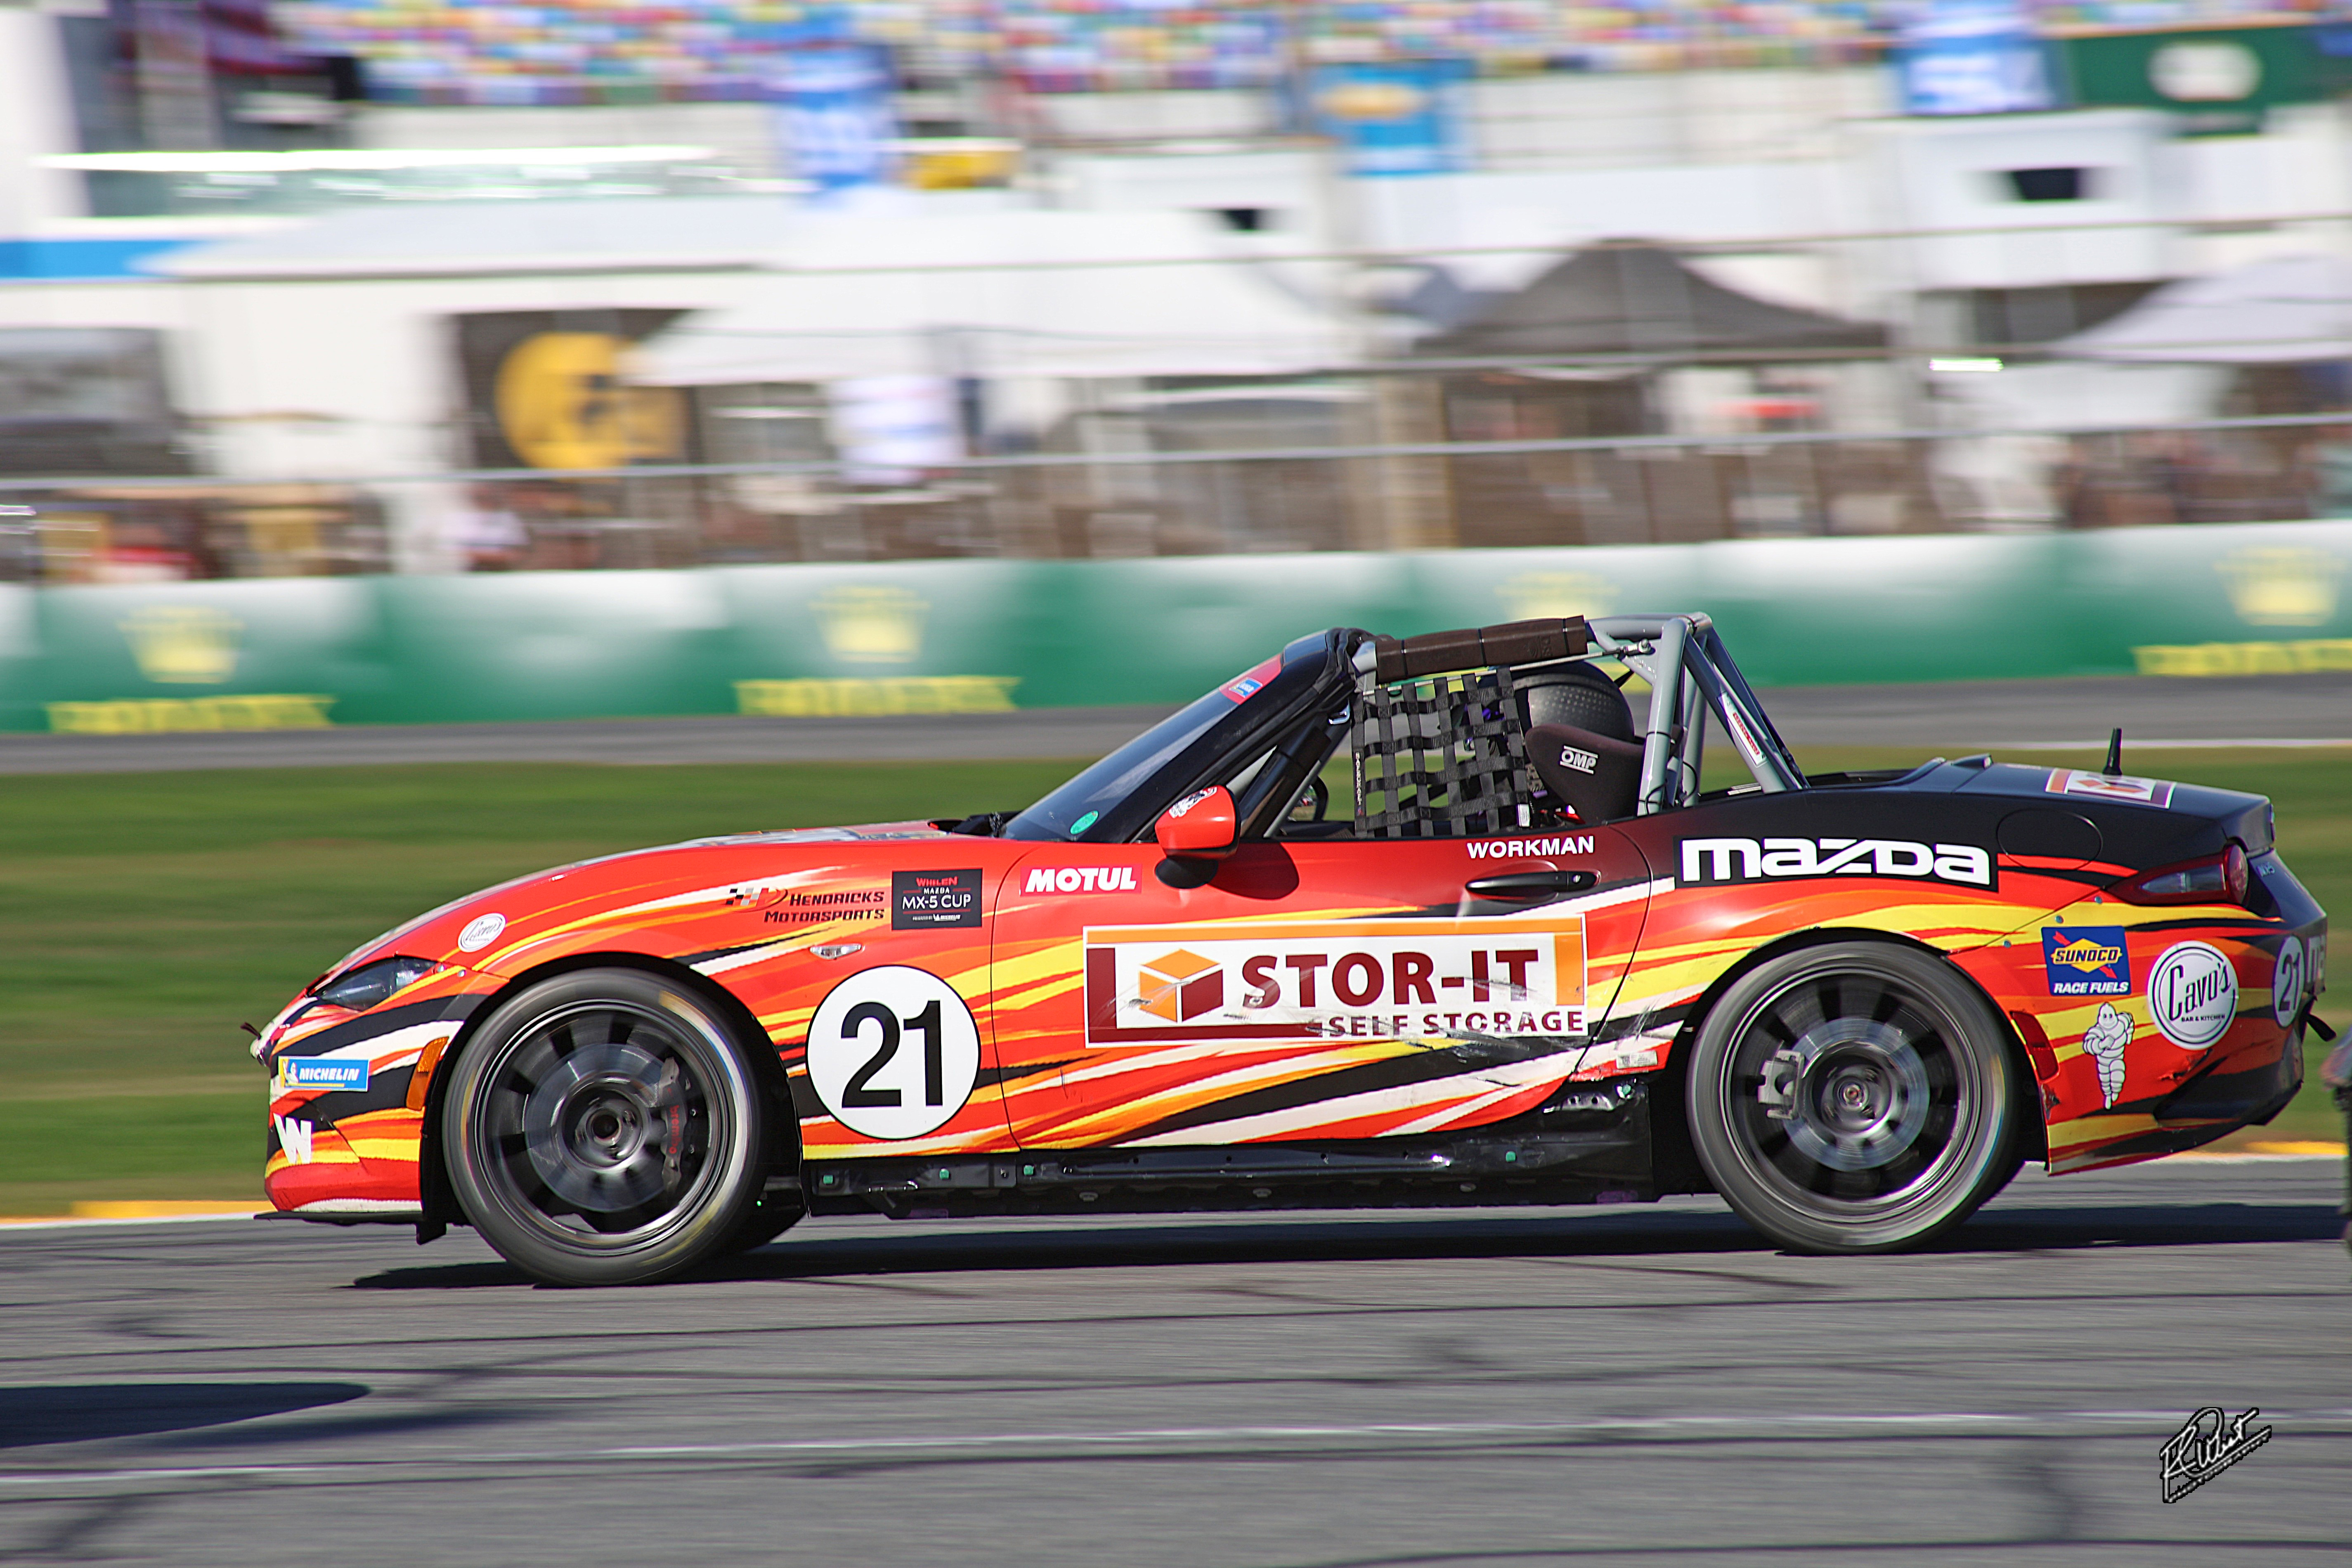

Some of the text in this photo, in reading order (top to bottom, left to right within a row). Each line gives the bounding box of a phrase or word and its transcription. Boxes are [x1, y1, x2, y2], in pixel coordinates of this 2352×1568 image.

[1561, 750, 1596, 770] OMP
[1467, 836, 1594, 859] WORKMAN
[916, 876, 959, 887] WHELEN
[1025, 866, 1137, 892] MOTUL
[903, 894, 972, 910] MX-5 CUP
[2054, 948, 2120, 963] SUNOCO
[1241, 948, 1539, 1009] STOR-IT
[2054, 981, 2129, 994] RACE FUELS
[2279, 952, 2301, 1011] 21
[2169, 963, 2231, 1021] Cavo's
[1329, 1010, 1584, 1038] SELF STORAGE
[840, 1000, 943, 1109] 21
[299, 1068, 360, 1081] MICHELIN
[669, 1105, 682, 1154] brembo
